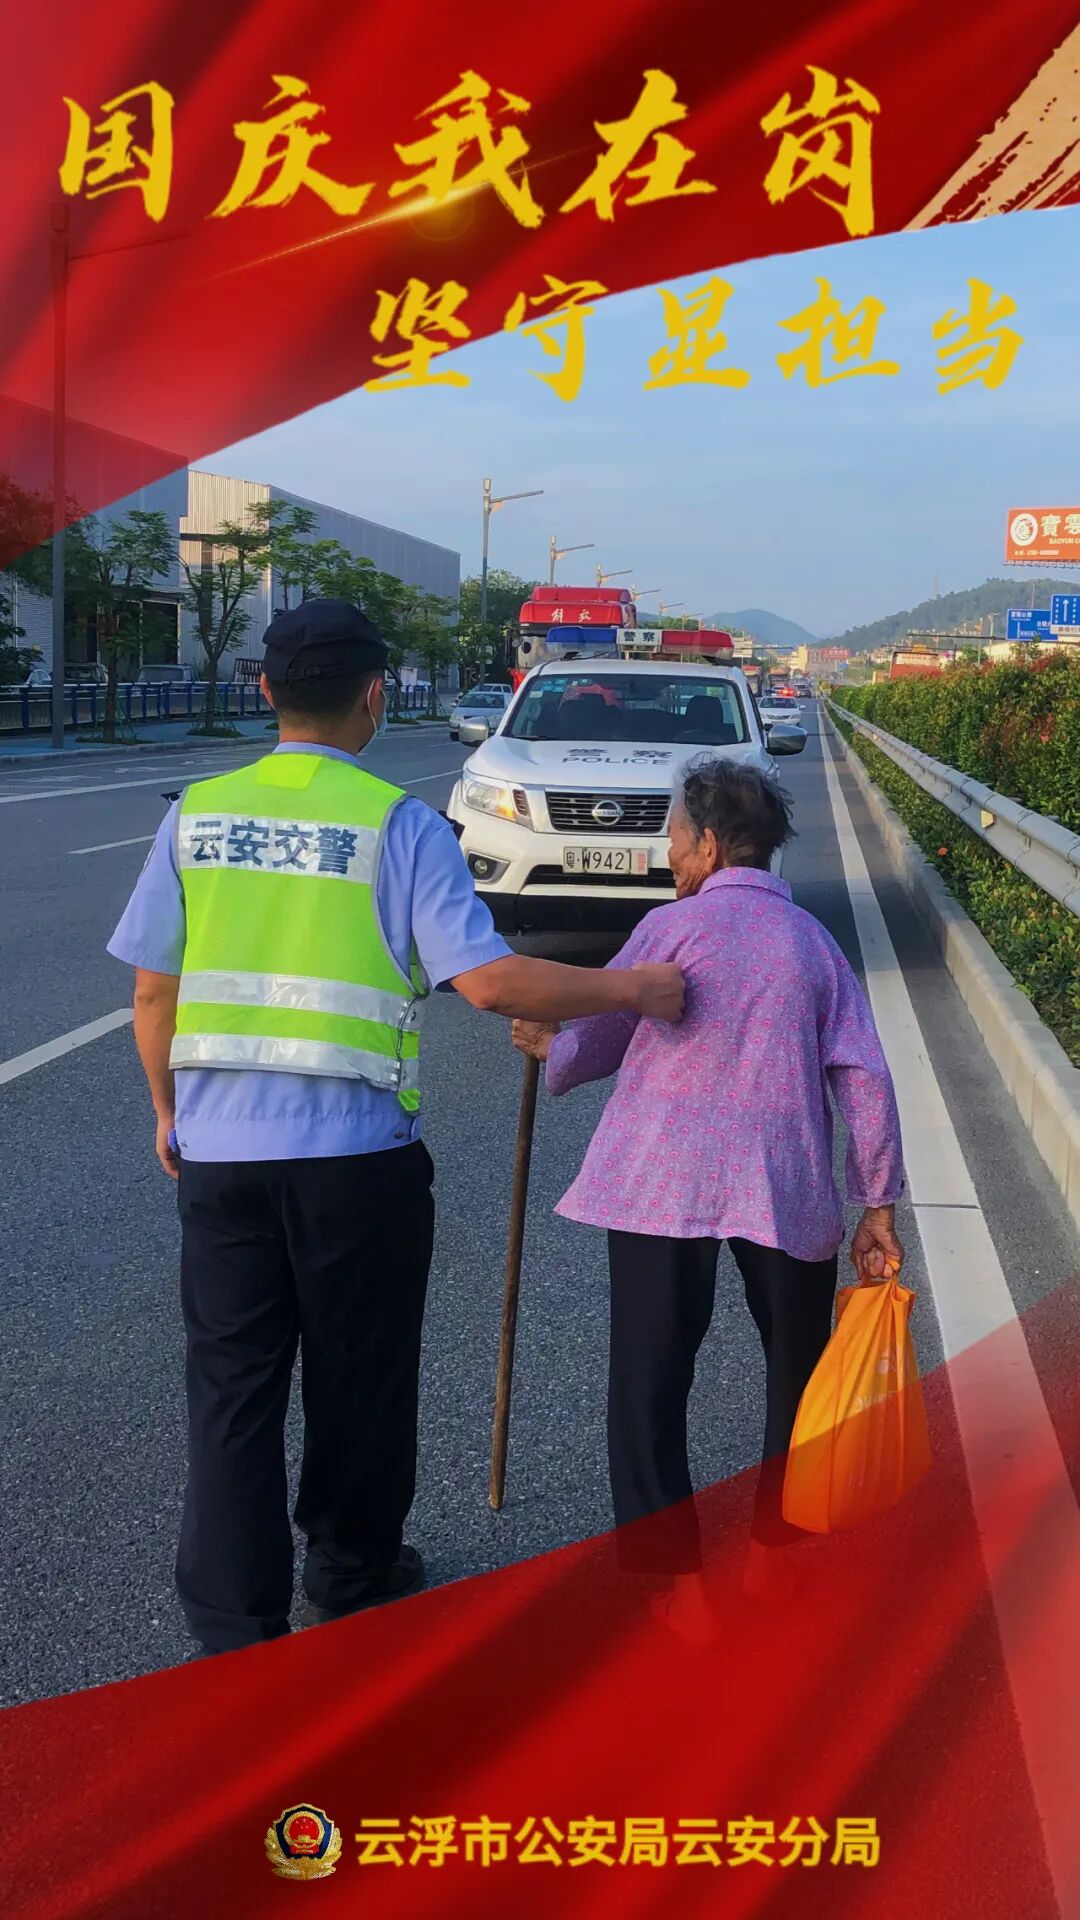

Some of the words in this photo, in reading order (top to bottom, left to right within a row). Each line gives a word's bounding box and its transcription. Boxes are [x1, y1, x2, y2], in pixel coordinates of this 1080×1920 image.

[551, 608, 592, 624] 解放
[623, 631, 655, 642] 警察
[562, 757, 671, 766] POLICE
[190, 820, 358, 875] 云安交警
